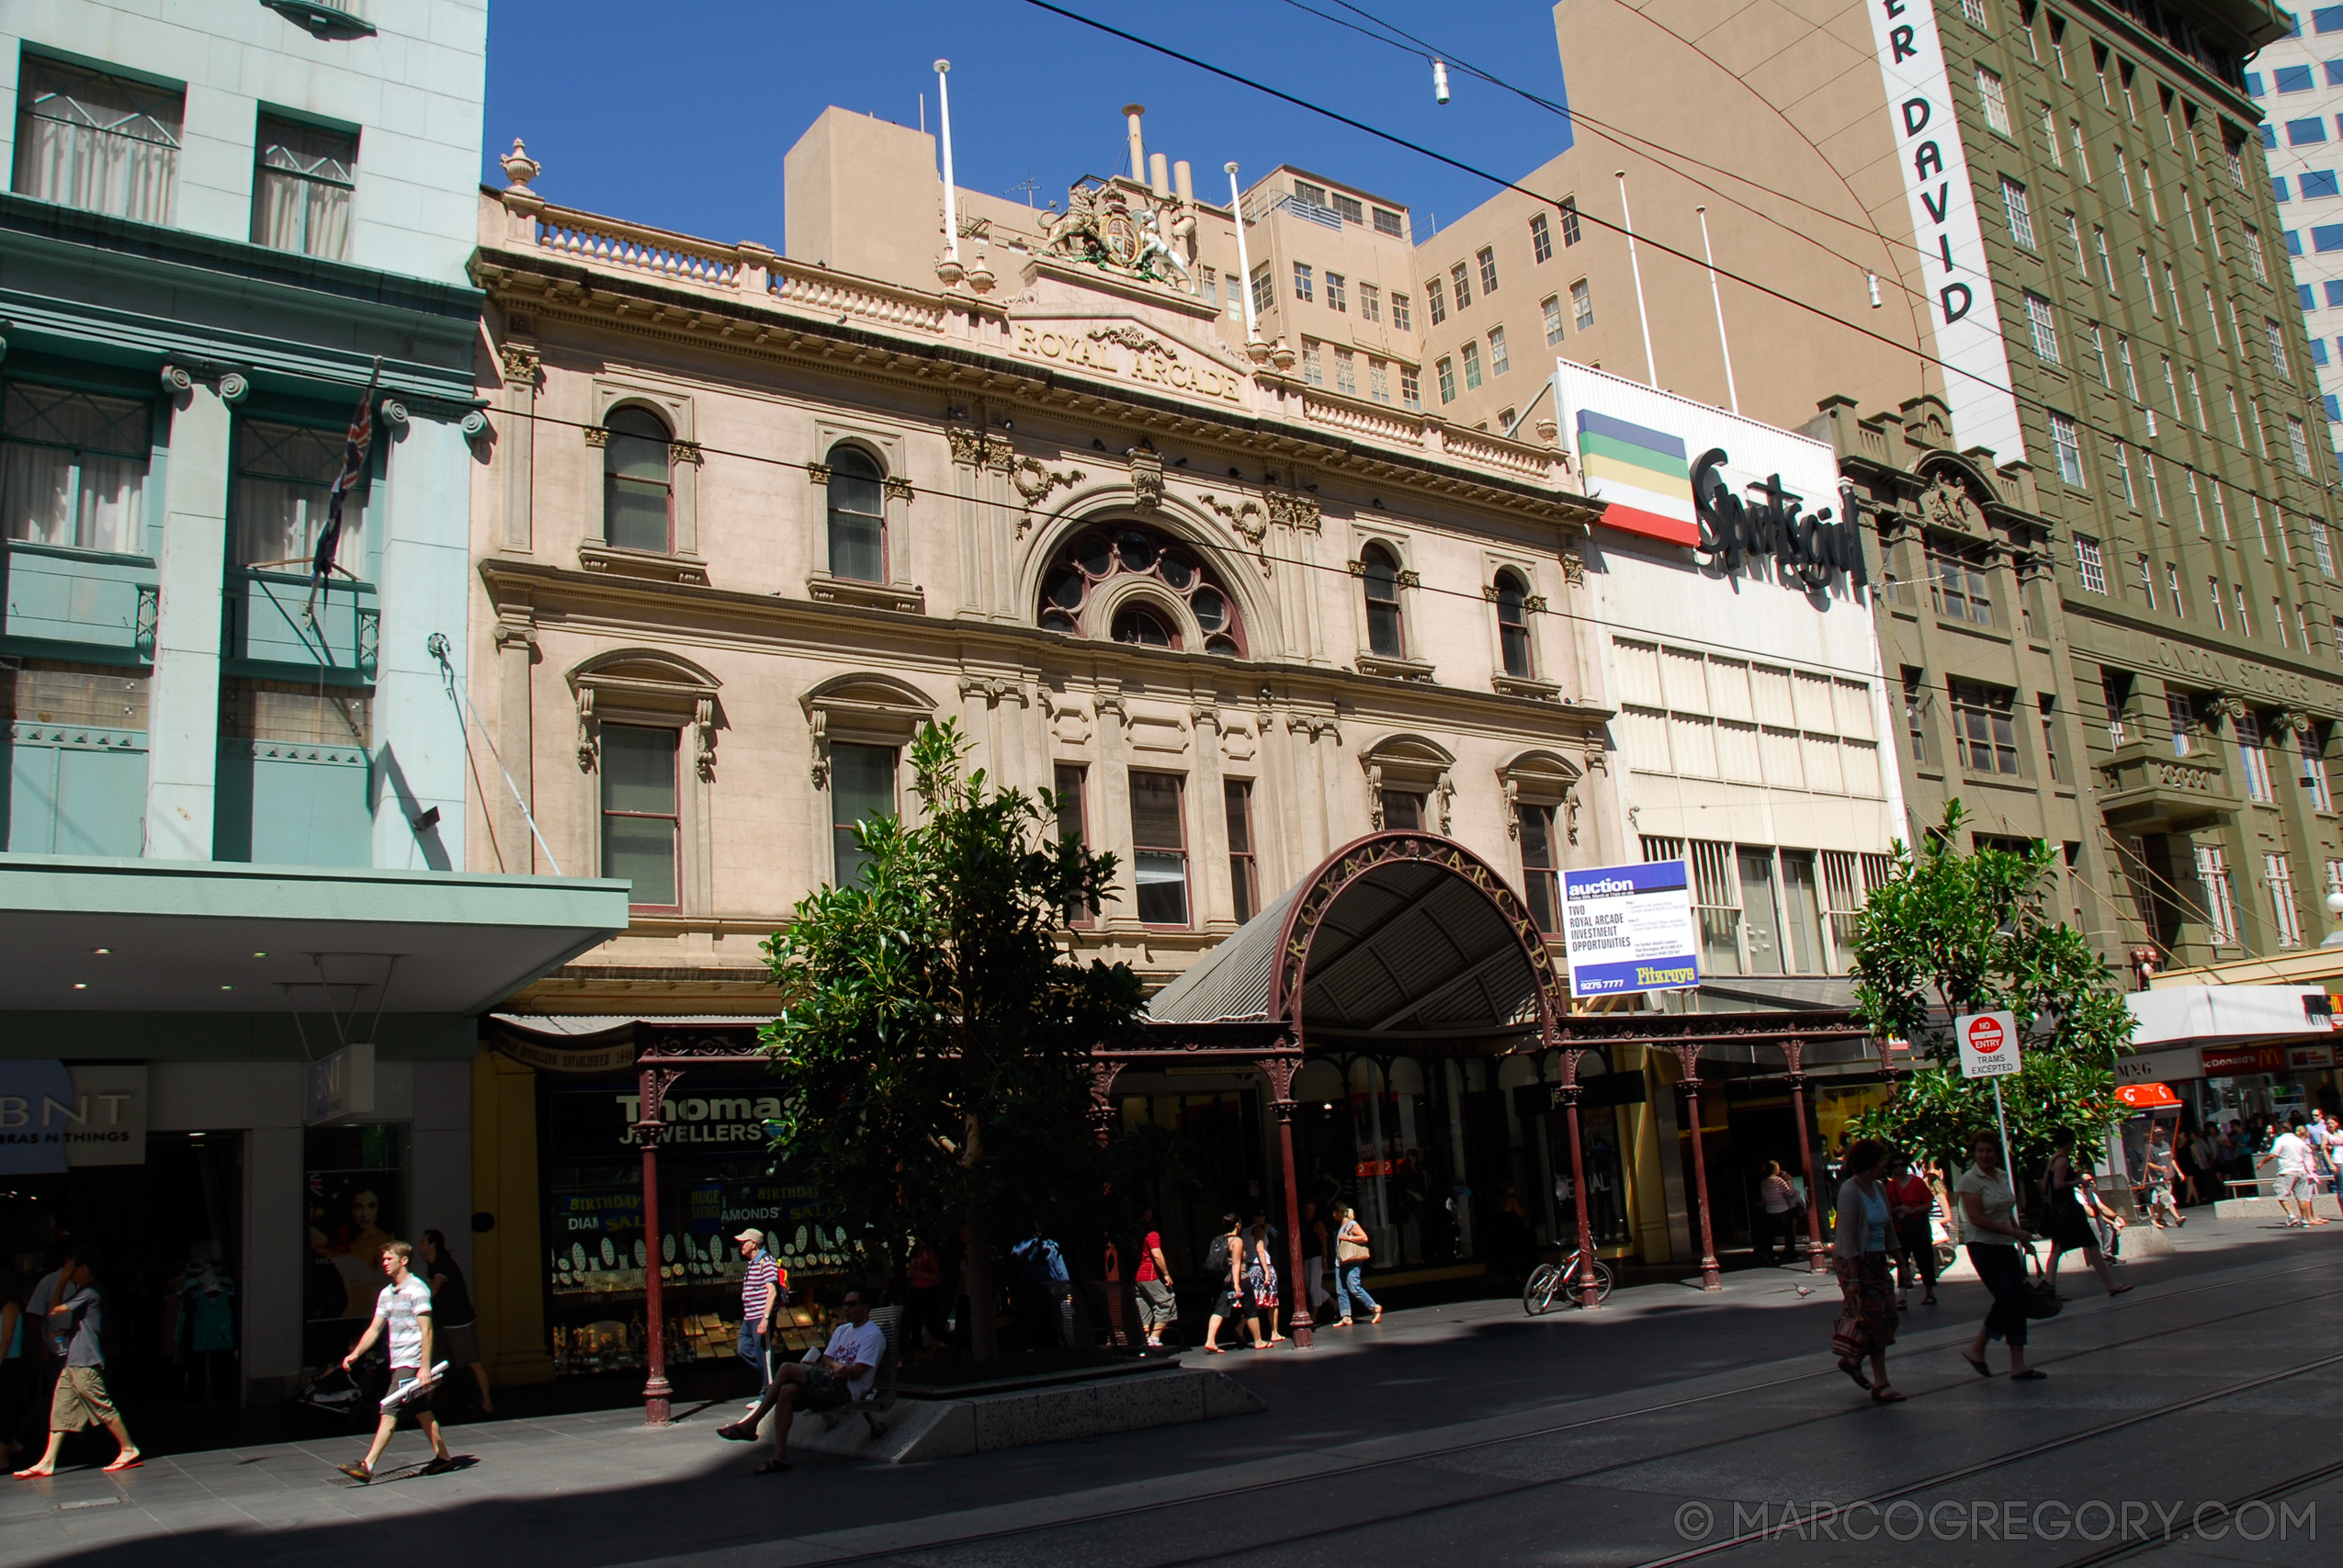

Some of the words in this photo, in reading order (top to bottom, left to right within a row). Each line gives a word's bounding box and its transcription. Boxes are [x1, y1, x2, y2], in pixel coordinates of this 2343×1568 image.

[1902, 97, 1972, 325] DAVID
[1018, 324, 1117, 373] ROYAL
[1131, 353, 1239, 401] ARCADE
[1690, 447, 1868, 590] Sportsgirl
[2146, 637, 2228, 682] LONDON
[2236, 658, 2310, 702] STORES
[1568, 877, 1634, 897] auction
[1568, 905, 1585, 916] TWO
[1287, 846, 1382, 961] ROYAL
[1446, 851, 1561, 1002] ARCADE
[1570, 917, 1592, 928] ROYAL
[1595, 913, 1624, 925] ARCADE
[1571, 926, 1617, 940] INVESTMENT
[1572, 936, 1631, 952] OPPORTUNITIES
[1602, 979, 1624, 988] 7777
[1636, 966, 1695, 986] Fitzroys
[1979, 1021, 1990, 1030] NO
[1975, 1039, 2000, 1049] ENTRY
[1977, 1055, 2005, 1064] TRAMS
[1972, 1064, 2013, 1075] EXCEPTED
[2117, 1062, 2151, 1078] MNG
[0, 1094, 131, 1128] BNT
[46, 1134, 58, 1143] N
[63, 1132, 130, 1142] THINGS
[570, 1196, 641, 1211] BIRTHDAY
[691, 1190, 720, 1205] HUGE
[721, 1206, 780, 1222] AMONDS
[606, 1215, 646, 1232] SAL
[612, 1292, 646, 1302] DIAMON
